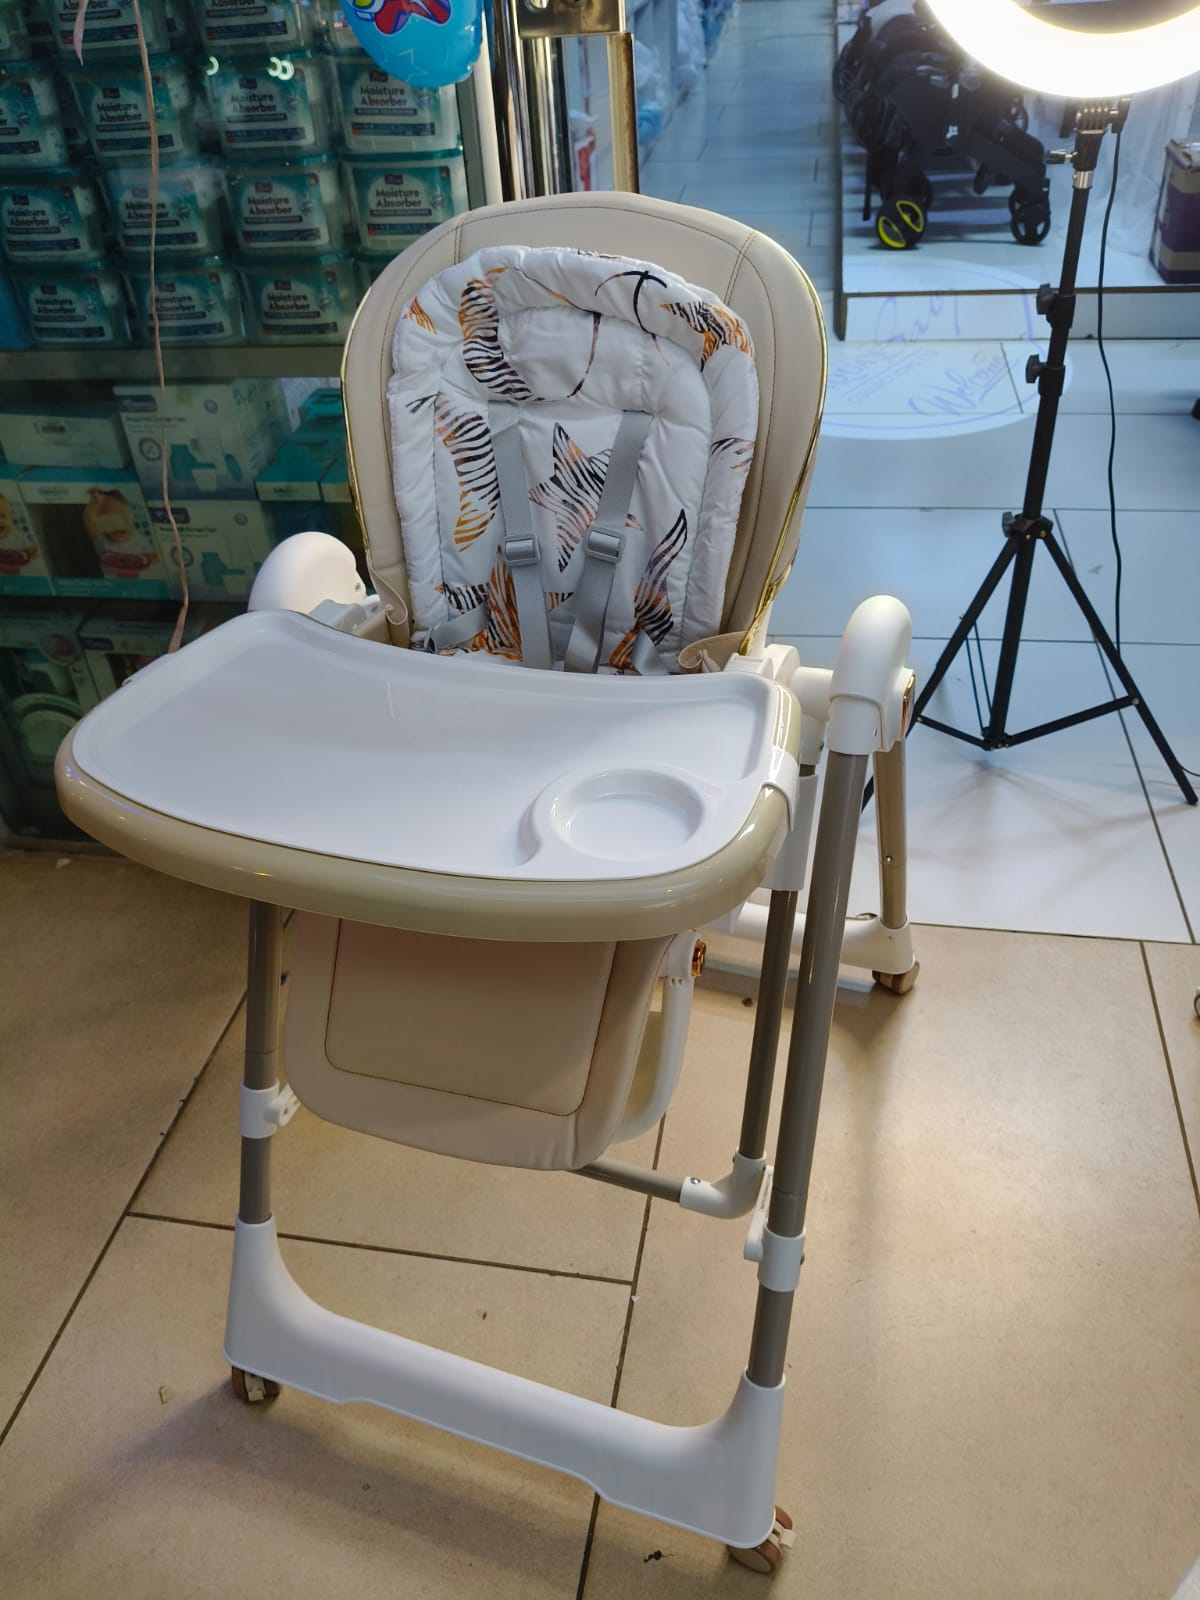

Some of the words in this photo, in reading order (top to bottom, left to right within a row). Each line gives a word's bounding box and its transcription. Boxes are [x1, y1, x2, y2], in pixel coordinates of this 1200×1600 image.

[360, 86, 405, 96] Moisture
[231, 92, 275, 103] Moisture
[361, 95, 408, 107] Absorber
[97, 102, 139, 112] Moisture
[232, 101, 277, 113] Absorber
[99, 111, 142, 123] Absorber
[375, 188, 420, 198] Moisture
[125, 201, 166, 211] Moistre
[247, 196, 290, 206] Moisture
[376, 197, 422, 208] Absorber
[7, 208, 46, 218] Moisture
[127, 210, 169, 220] Absorer
[249, 205, 292, 216] Absorber
[9, 215, 50, 227] Absorber
[266, 293, 308, 303] Moisture
[268, 302, 311, 312] Absorber
